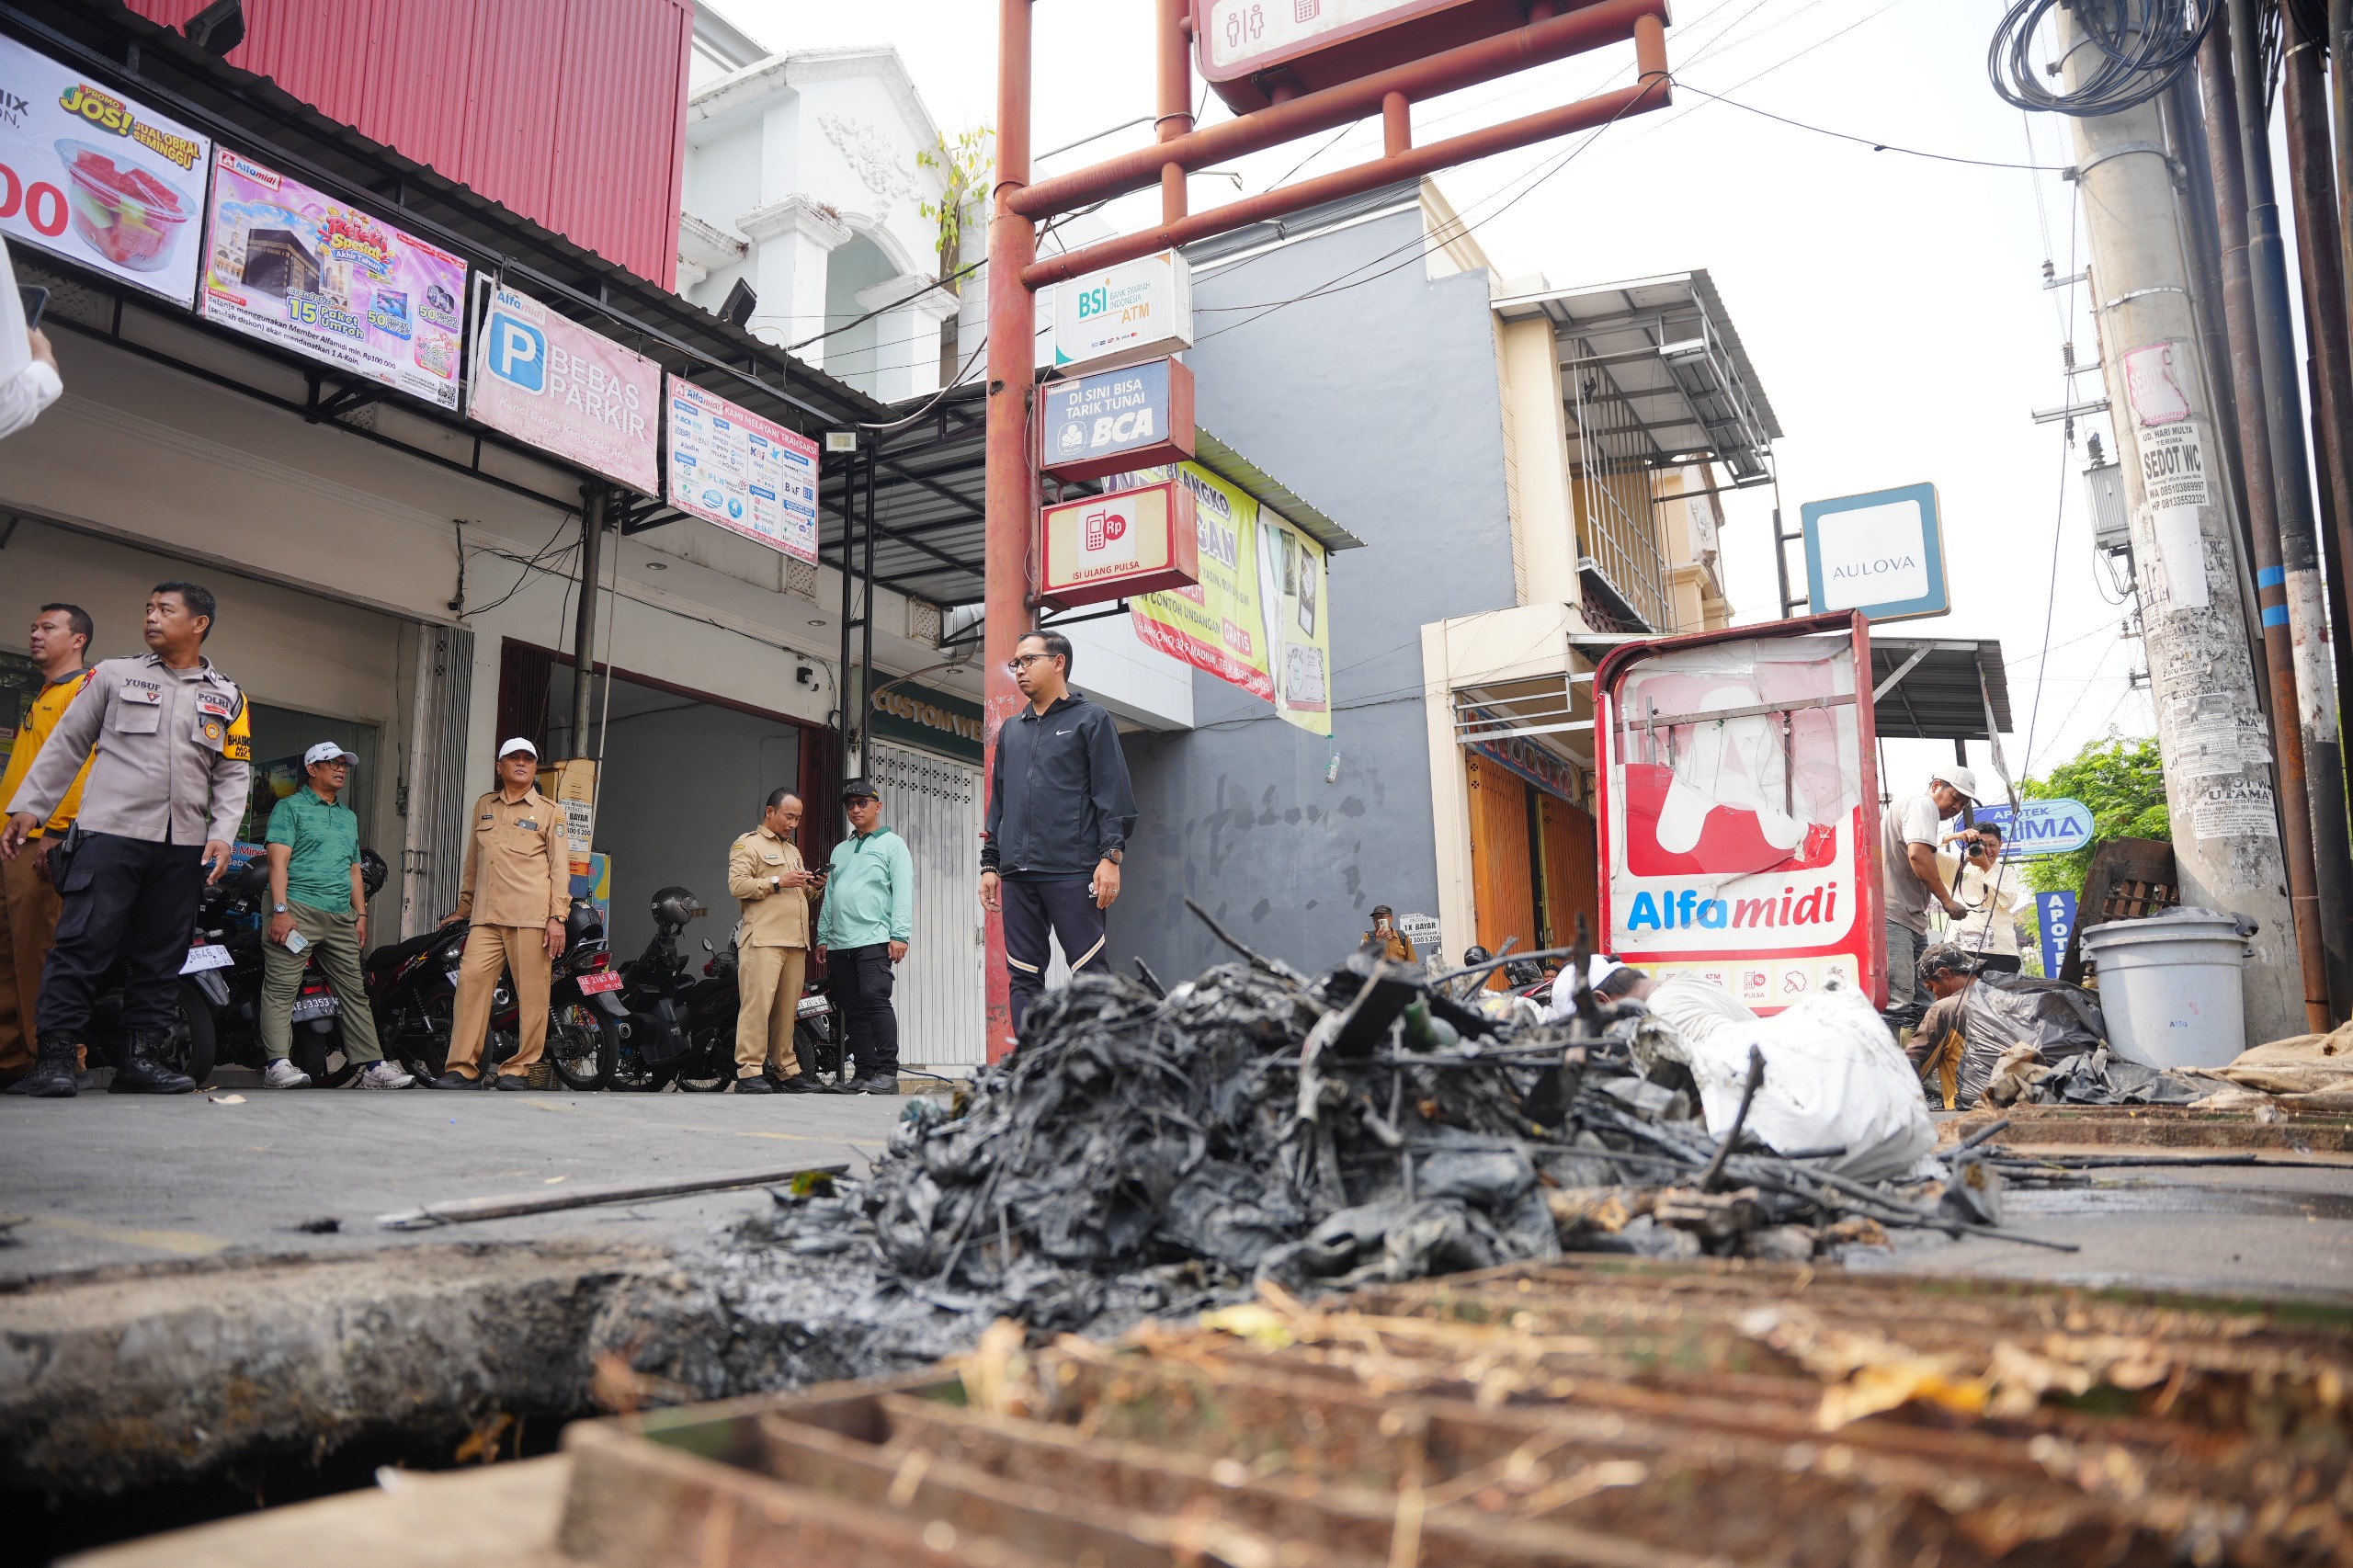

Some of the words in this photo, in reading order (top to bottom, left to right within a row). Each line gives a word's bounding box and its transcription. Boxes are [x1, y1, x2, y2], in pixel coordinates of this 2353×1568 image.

[85, 87, 120, 109] PROMO
[0, 108, 19, 129] N,
[59, 90, 135, 135] JOS!
[132, 131, 193, 171] SEMINGGU
[134, 121, 164, 142] JUAL
[163, 132, 200, 160] OBRAL
[235, 161, 277, 186] Alfamidi
[326, 216, 388, 252] Rejeki
[330, 233, 381, 262] Spesial
[335, 250, 356, 260] Akhir
[357, 254, 381, 271] Tahun
[287, 286, 335, 307] Grandprize
[1109, 289, 1126, 301] BANK
[1127, 281, 1151, 297] SYARIAH
[1109, 293, 1142, 310] INDONESIA
[288, 296, 317, 324] 15
[419, 304, 436, 320] 50
[497, 291, 543, 322] Alfamidi
[1079, 286, 1107, 319] BSI
[1121, 301, 1150, 324] ATM
[320, 306, 358, 326] Paket
[368, 310, 386, 326] 50
[208, 304, 236, 322] (setelah
[237, 316, 265, 332] diskon)
[266, 325, 282, 337] akan
[283, 334, 330, 355] mendapatkan
[208, 295, 235, 311] Belanja
[236, 306, 288, 330] menggunakan
[289, 324, 320, 340] Member
[320, 335, 347, 351] Alfamidi
[363, 352, 396, 369] Rp100.000
[320, 317, 364, 339] Umroh
[502, 322, 536, 375] P
[551, 344, 640, 411] BEBAS
[687, 389, 721, 411] Alfamidi
[1069, 392, 1082, 404] DI
[1086, 385, 1110, 402] SINI
[1113, 378, 1142, 395] BISA
[549, 371, 646, 443] PARKIR
[1065, 401, 1102, 419] TARIK
[1104, 392, 1145, 411] TUNAI
[499, 397, 529, 416] Kunci
[530, 410, 561, 431] Ganda
[563, 425, 609, 453] Kendaraan
[611, 447, 632, 463] Anda
[680, 415, 692, 426] BCA
[723, 406, 744, 422] KAMI
[745, 415, 779, 438] MELAYANI
[780, 432, 817, 455] TRANSAKSI
[1091, 407, 1154, 448] BCA
[2143, 432, 2154, 442] UD.
[2154, 427, 2171, 438] HARI
[2172, 426, 2193, 435] MULYA
[2156, 437, 2183, 447] TERIMA
[2143, 445, 2180, 480] SEDOT
[2182, 444, 2201, 472] WC
[2149, 488, 2160, 499] WA
[2152, 501, 2160, 512] HP
[1106, 518, 1122, 536] Rp
[1073, 569, 1083, 580] ISI
[1084, 564, 1112, 578] ULANG
[1114, 561, 1140, 576] PULSA
[1833, 555, 1915, 580] AULOVA
[1138, 621, 1175, 645] HARYONO
[1150, 592, 1183, 617] CONTOH
[1184, 607, 1221, 635] UNDANGAN
[1223, 622, 1250, 653] GRATIS
[125, 677, 162, 691] YUSUF
[198, 692, 231, 709] POLRI
[570, 812, 588, 823] BAYAR
[238, 845, 267, 857] Miner
[1627, 881, 1837, 931] Alfamidi
[1415, 922, 1437, 931] BAYAR
[581, 975, 590, 985] AE
[590, 974, 608, 984] 2185
[608, 972, 618, 982] BP
[1705, 972, 1721, 981] ATM
[1754, 976, 1764, 985] Rp
[1744, 991, 1765, 999] PULSA
